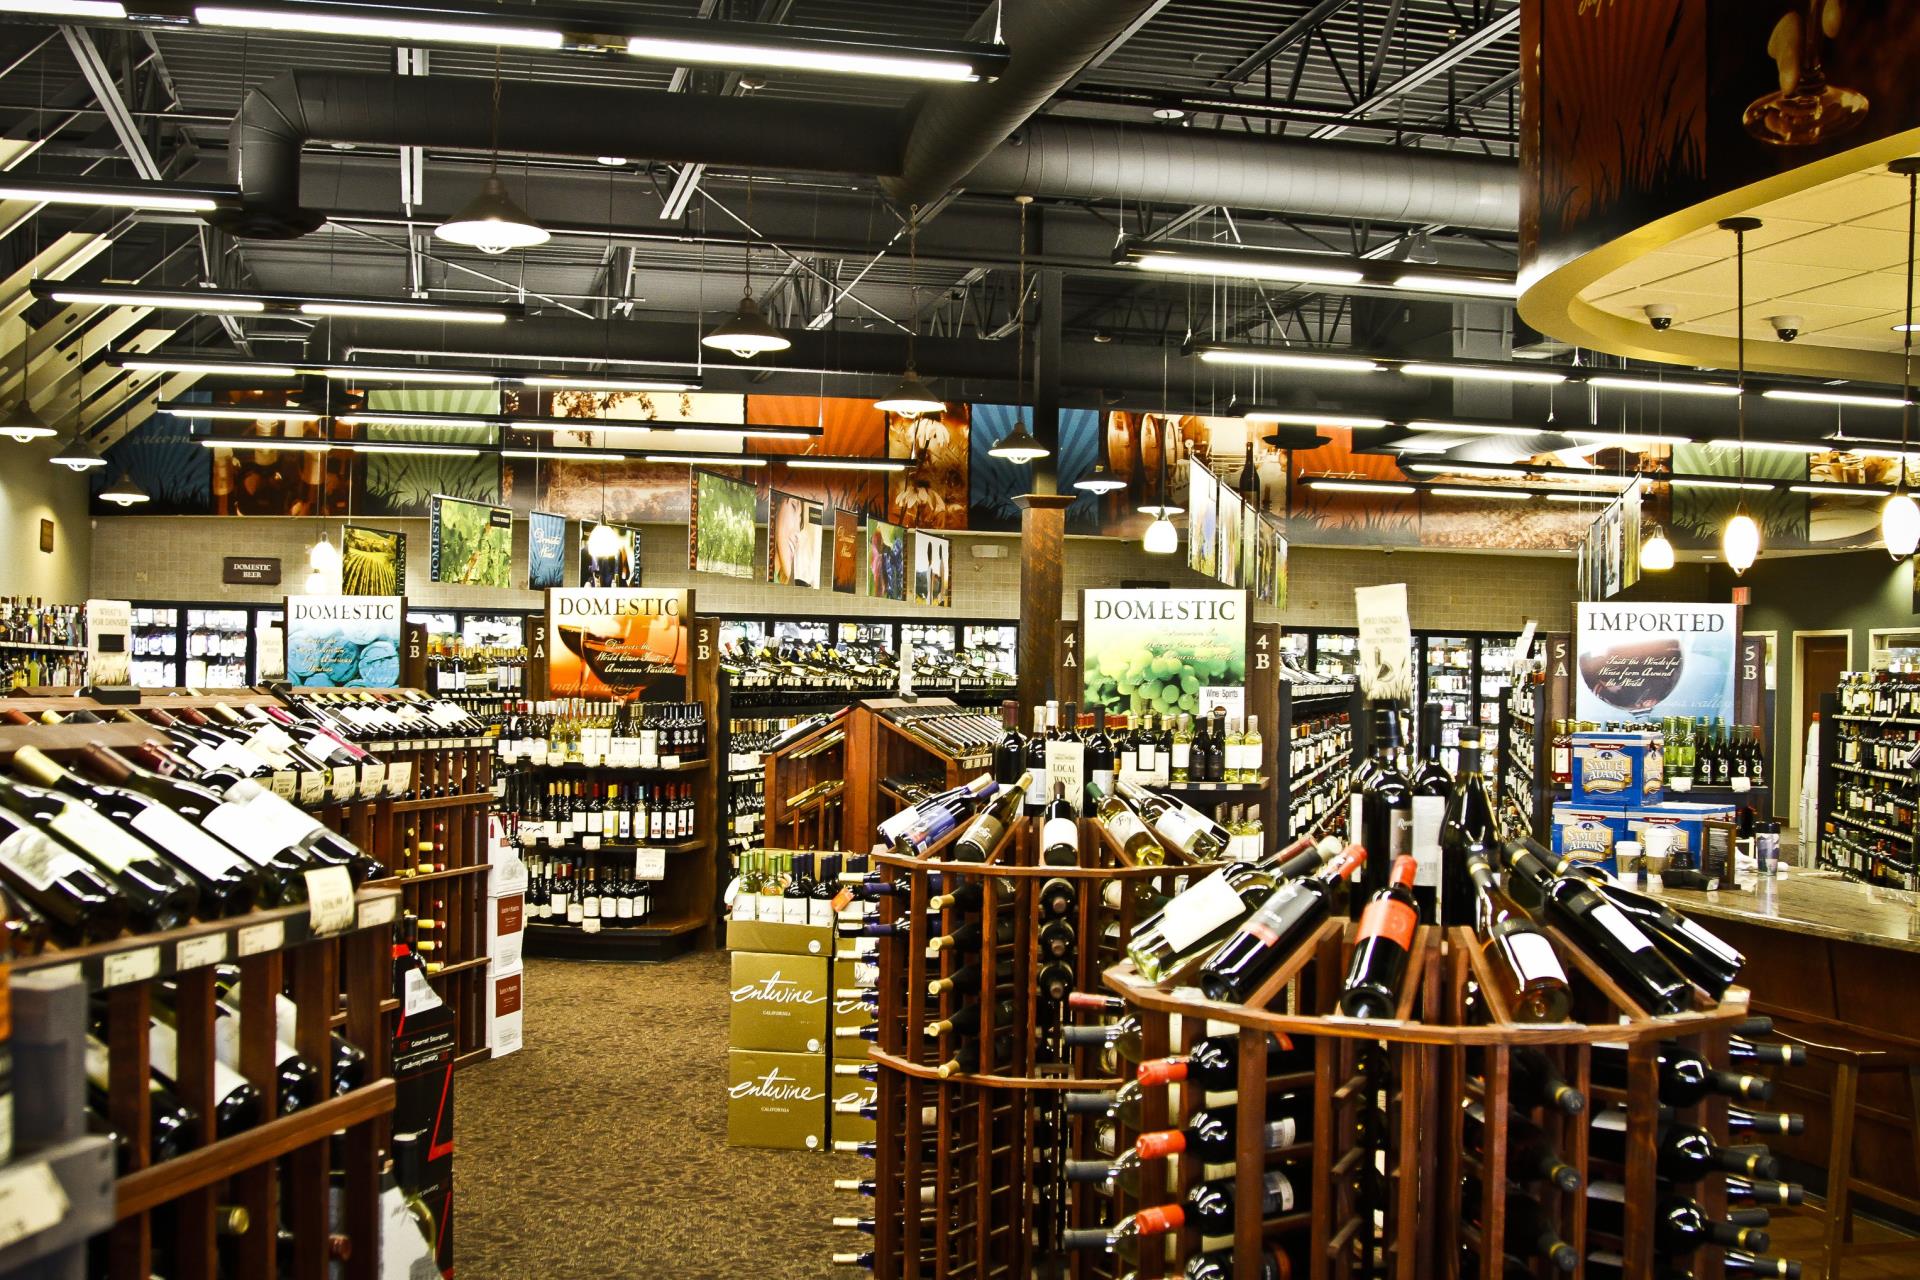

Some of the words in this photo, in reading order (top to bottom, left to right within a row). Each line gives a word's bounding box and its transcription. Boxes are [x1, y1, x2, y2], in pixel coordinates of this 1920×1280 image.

[431, 500, 440, 580] DOMESTIC
[633, 533, 641, 585] DOMEST
[233, 563, 272, 571] DOMESTIC
[295, 604, 394, 620] DOMESTIC
[558, 597, 680, 617] DOMESTIC
[1094, 600, 1236, 621] DOMESTIC
[1587, 612, 1725, 633] IMPORTED
[410, 630, 419, 643] 2
[534, 627, 545, 642] 3
[698, 629, 709, 643] 3
[1063, 633, 1076, 648] 4
[1256, 634, 1270, 650] 4
[409, 646, 420, 658] B
[533, 644, 545, 658] A
[595, 651, 618, 661] World
[697, 645, 711, 660] B
[1555, 643, 1566, 659] 5
[1745, 646, 1755, 662] 5
[1063, 652, 1077, 667] A
[1255, 653, 1270, 670] B
[604, 663, 642, 673] American
[1555, 662, 1569, 677] A
[1641, 667, 1676, 676] Around
[1743, 665, 1757, 680] B
[1619, 677, 1646, 687] World
[1053, 763, 1075, 773] LOCAL
[1587, 758, 1626, 771] SAMUEL
[1054, 776, 1076, 785] WINES
[1588, 770, 1625, 782] ADAMS
[1567, 830, 1606, 843] SAMUEL
[1569, 840, 1605, 853] ADAMS
[730, 971, 828, 1004] entwine
[762, 1009, 791, 1017] CALIFORNIA
[727, 1067, 826, 1100] entwine
